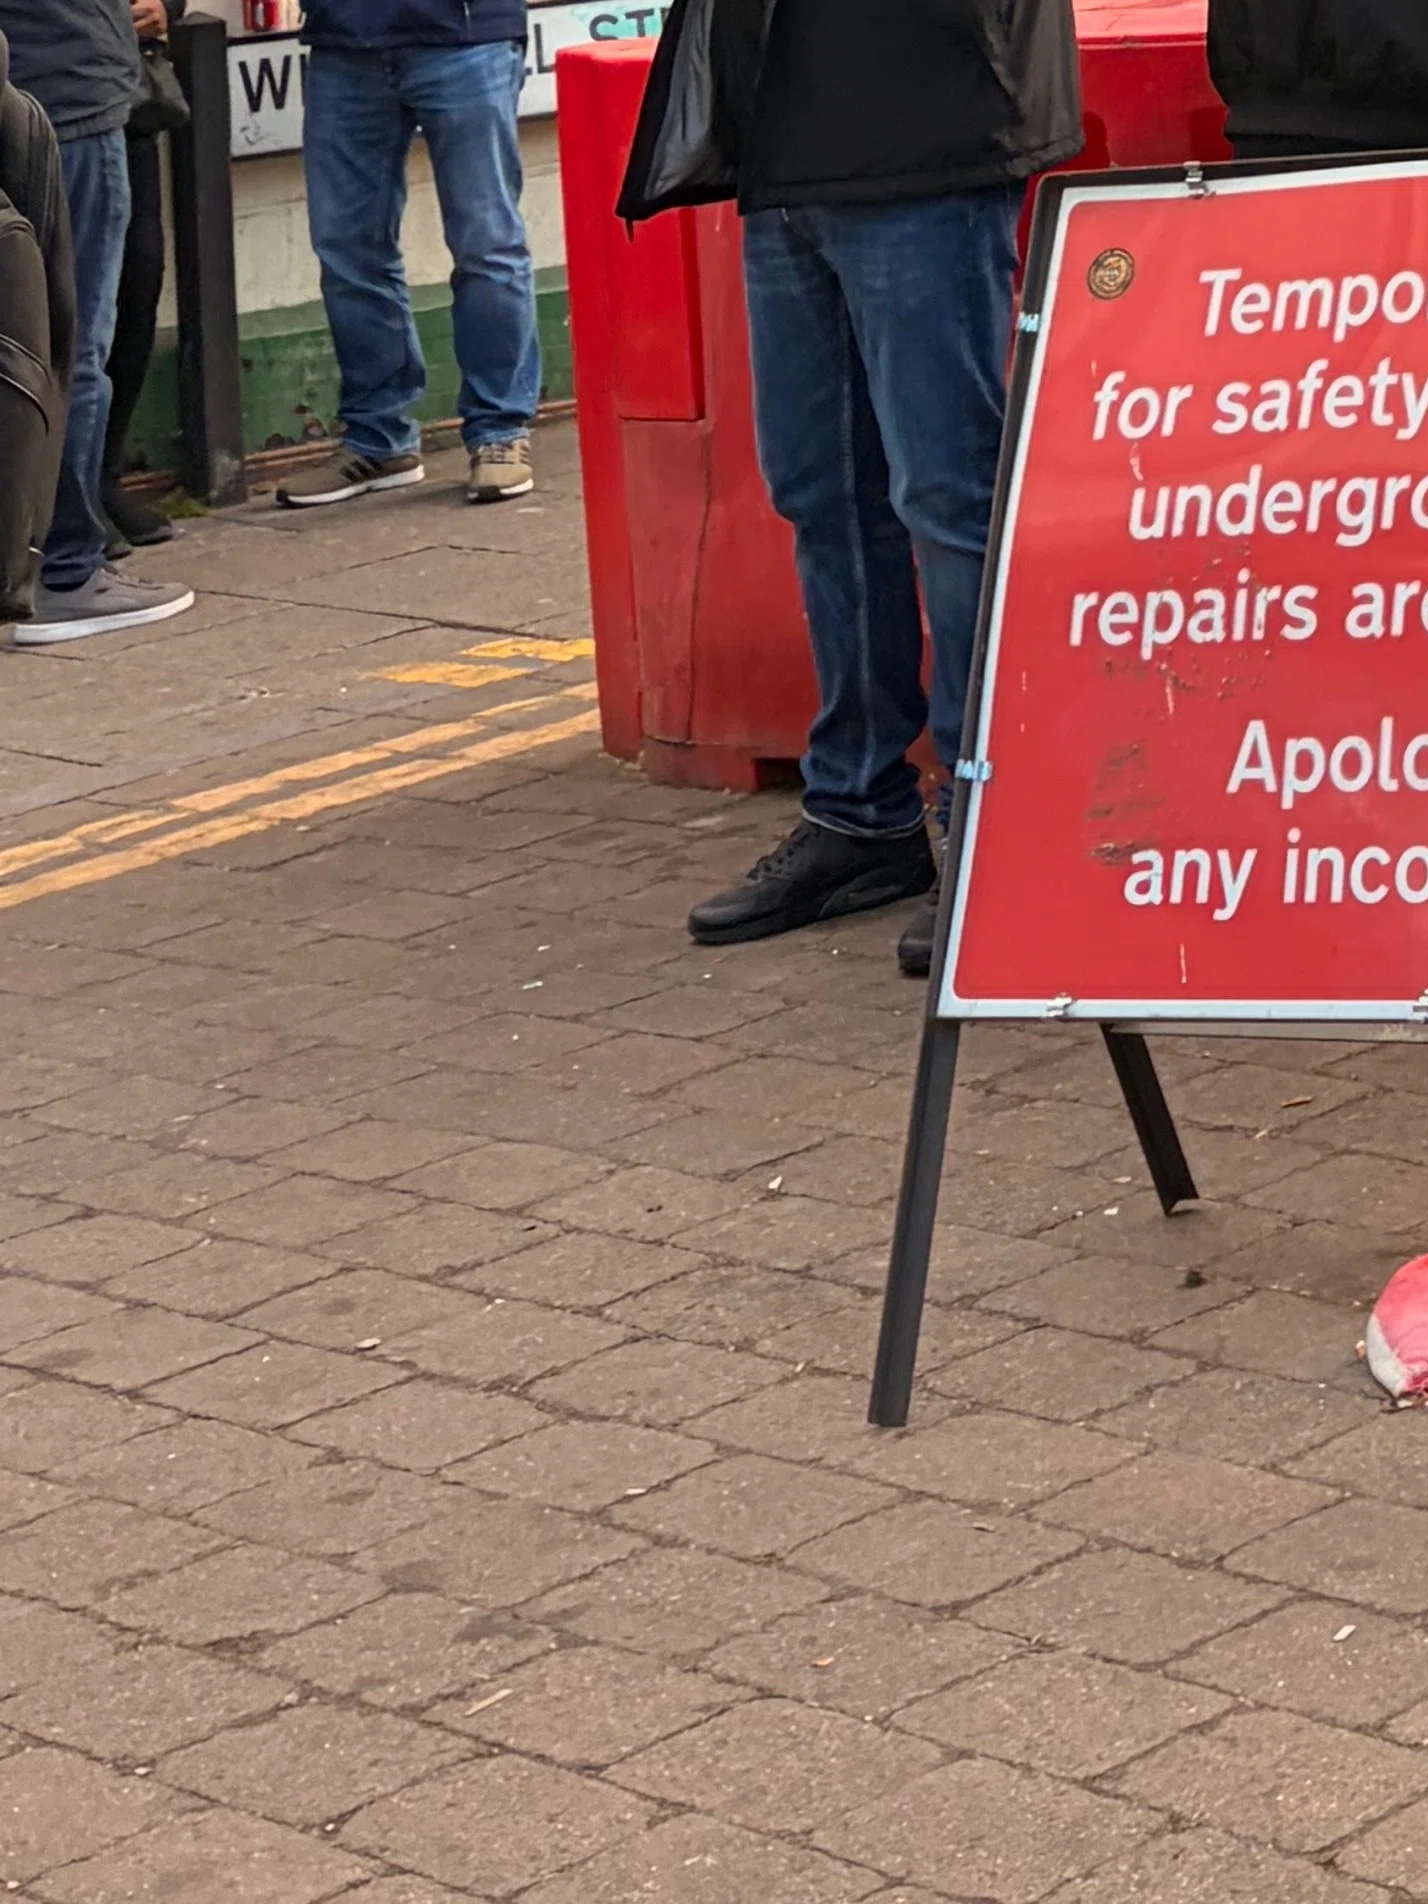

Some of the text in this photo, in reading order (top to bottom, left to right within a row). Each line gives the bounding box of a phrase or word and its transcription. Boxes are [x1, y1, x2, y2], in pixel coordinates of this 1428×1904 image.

[1093, 371, 1193, 440] for
[1070, 569, 1317, 659] repairs
[1123, 847, 1257, 921] any
